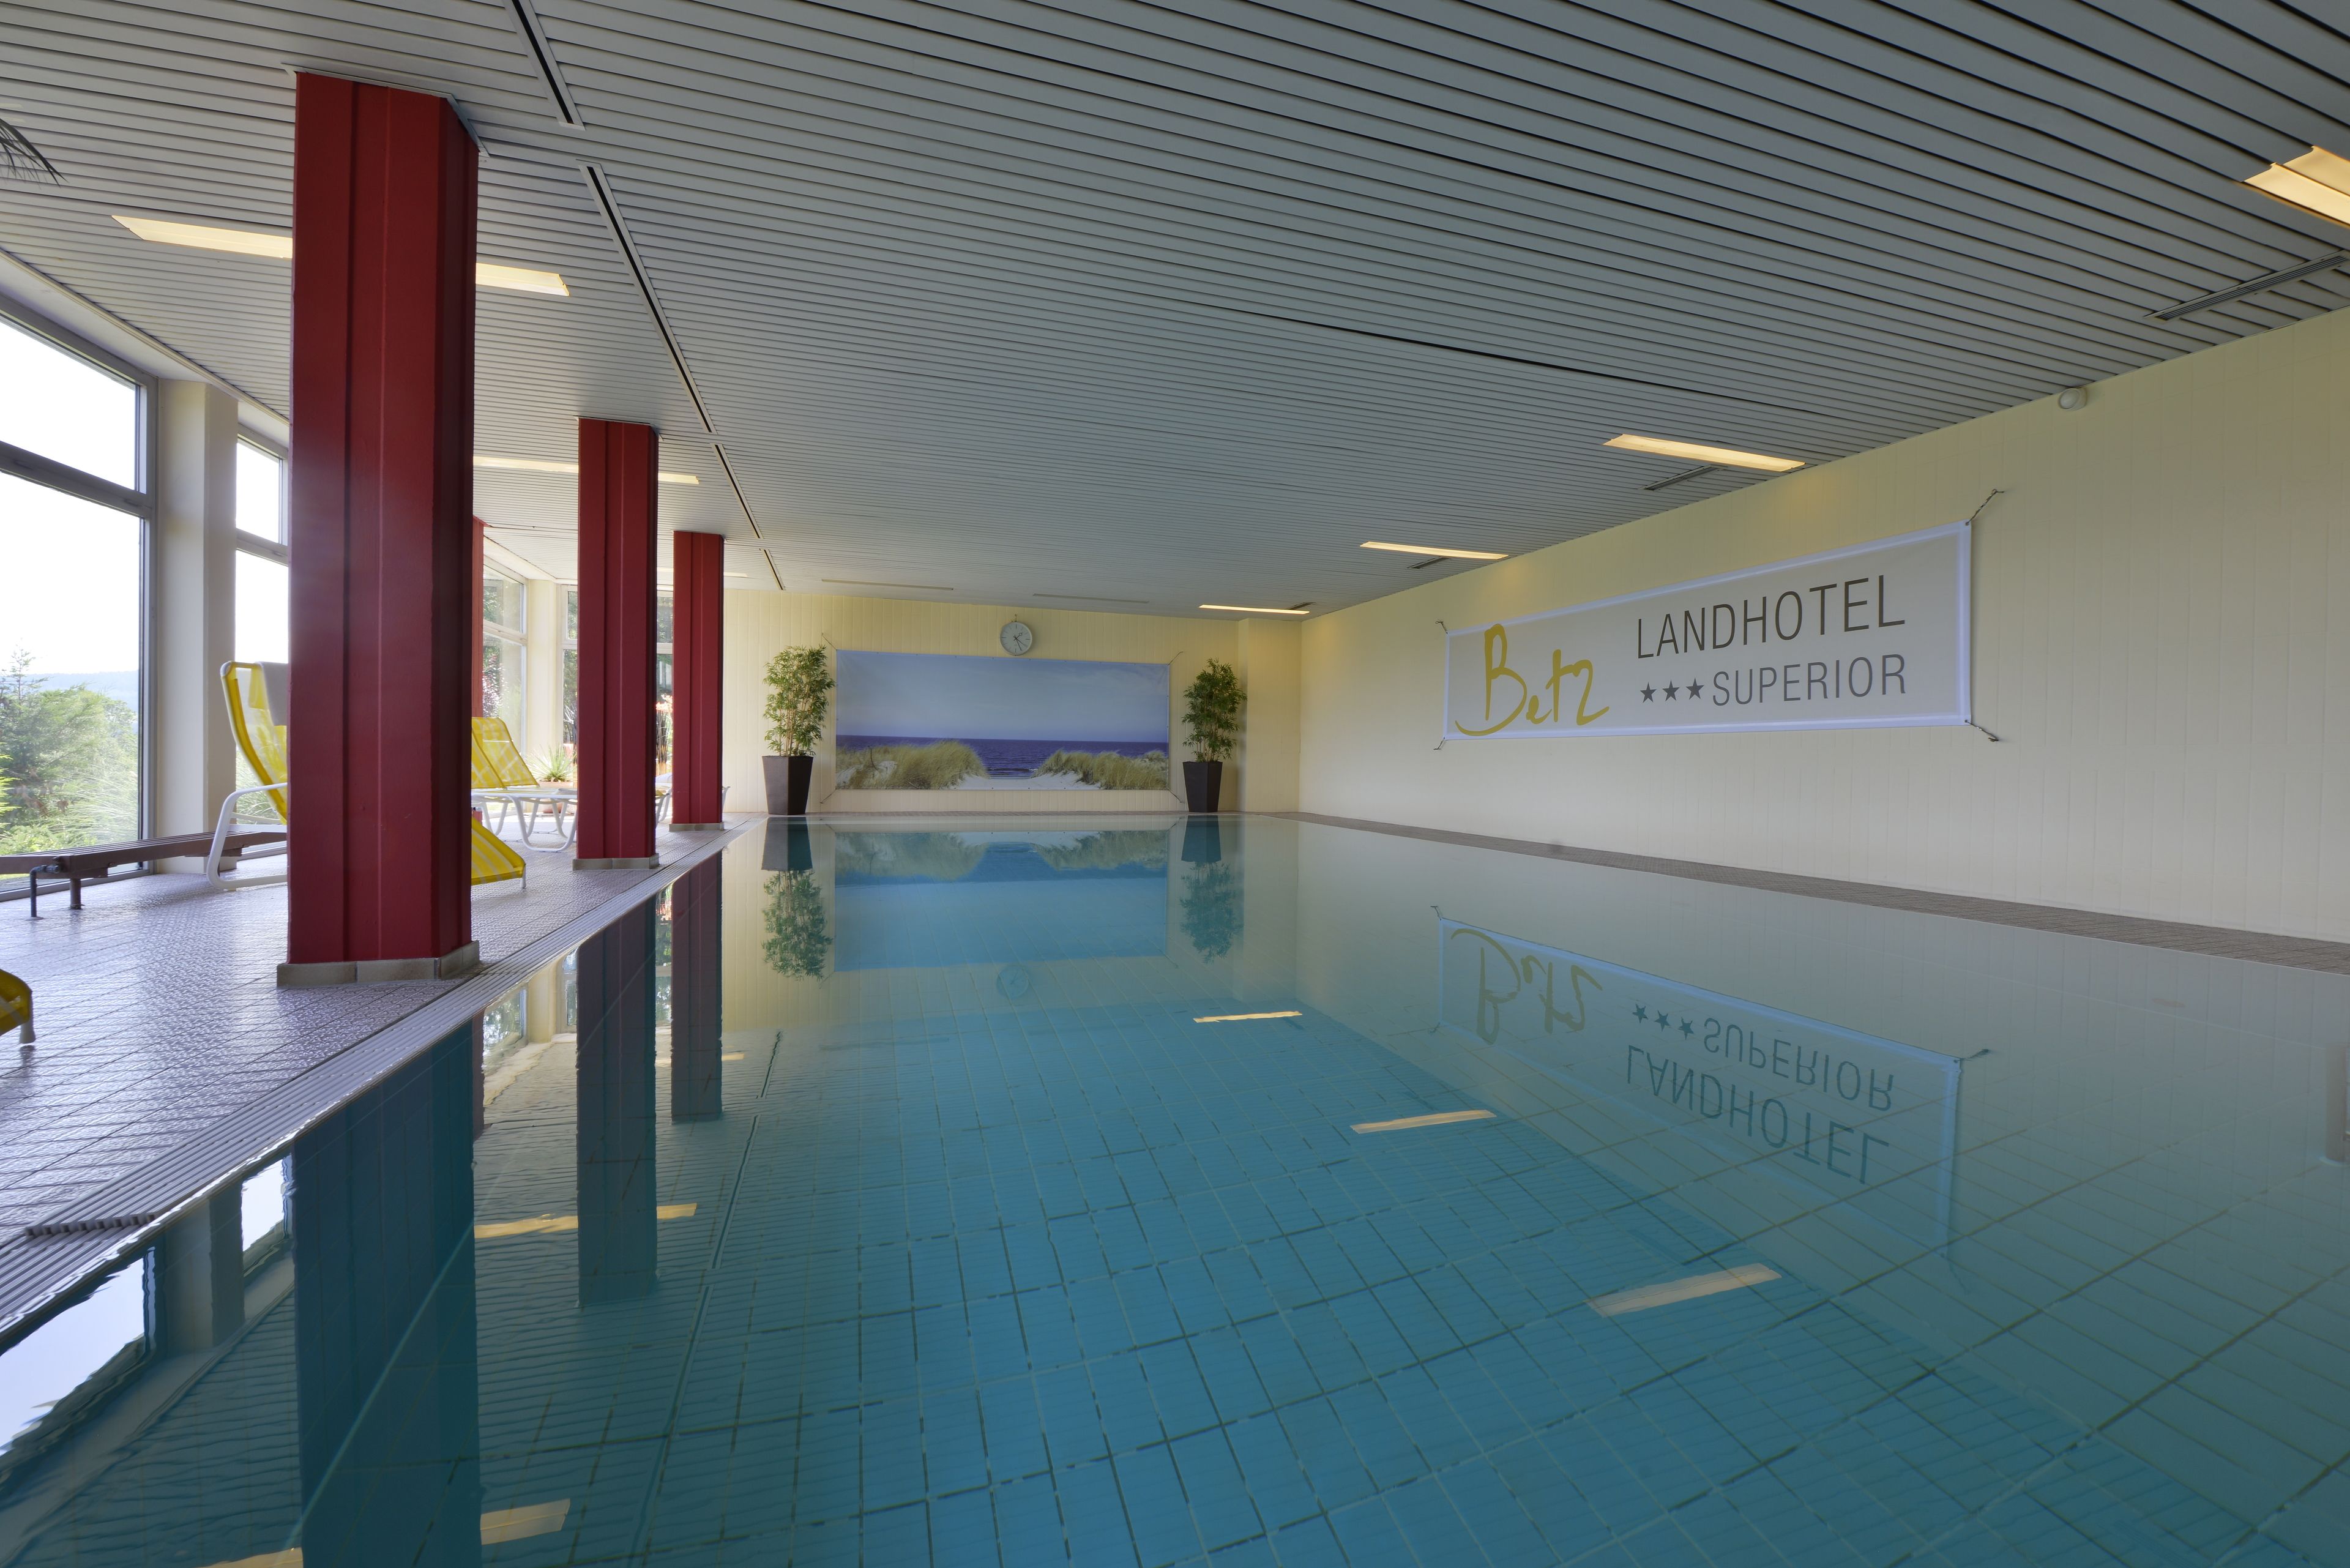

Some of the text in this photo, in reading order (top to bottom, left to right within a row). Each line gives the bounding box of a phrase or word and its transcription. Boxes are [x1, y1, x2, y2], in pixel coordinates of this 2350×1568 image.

[1637, 575, 1906, 659] LANDHOTEL
[1455, 623, 1610, 736] Betz
[1712, 654, 1906, 706] SUPERIOR
